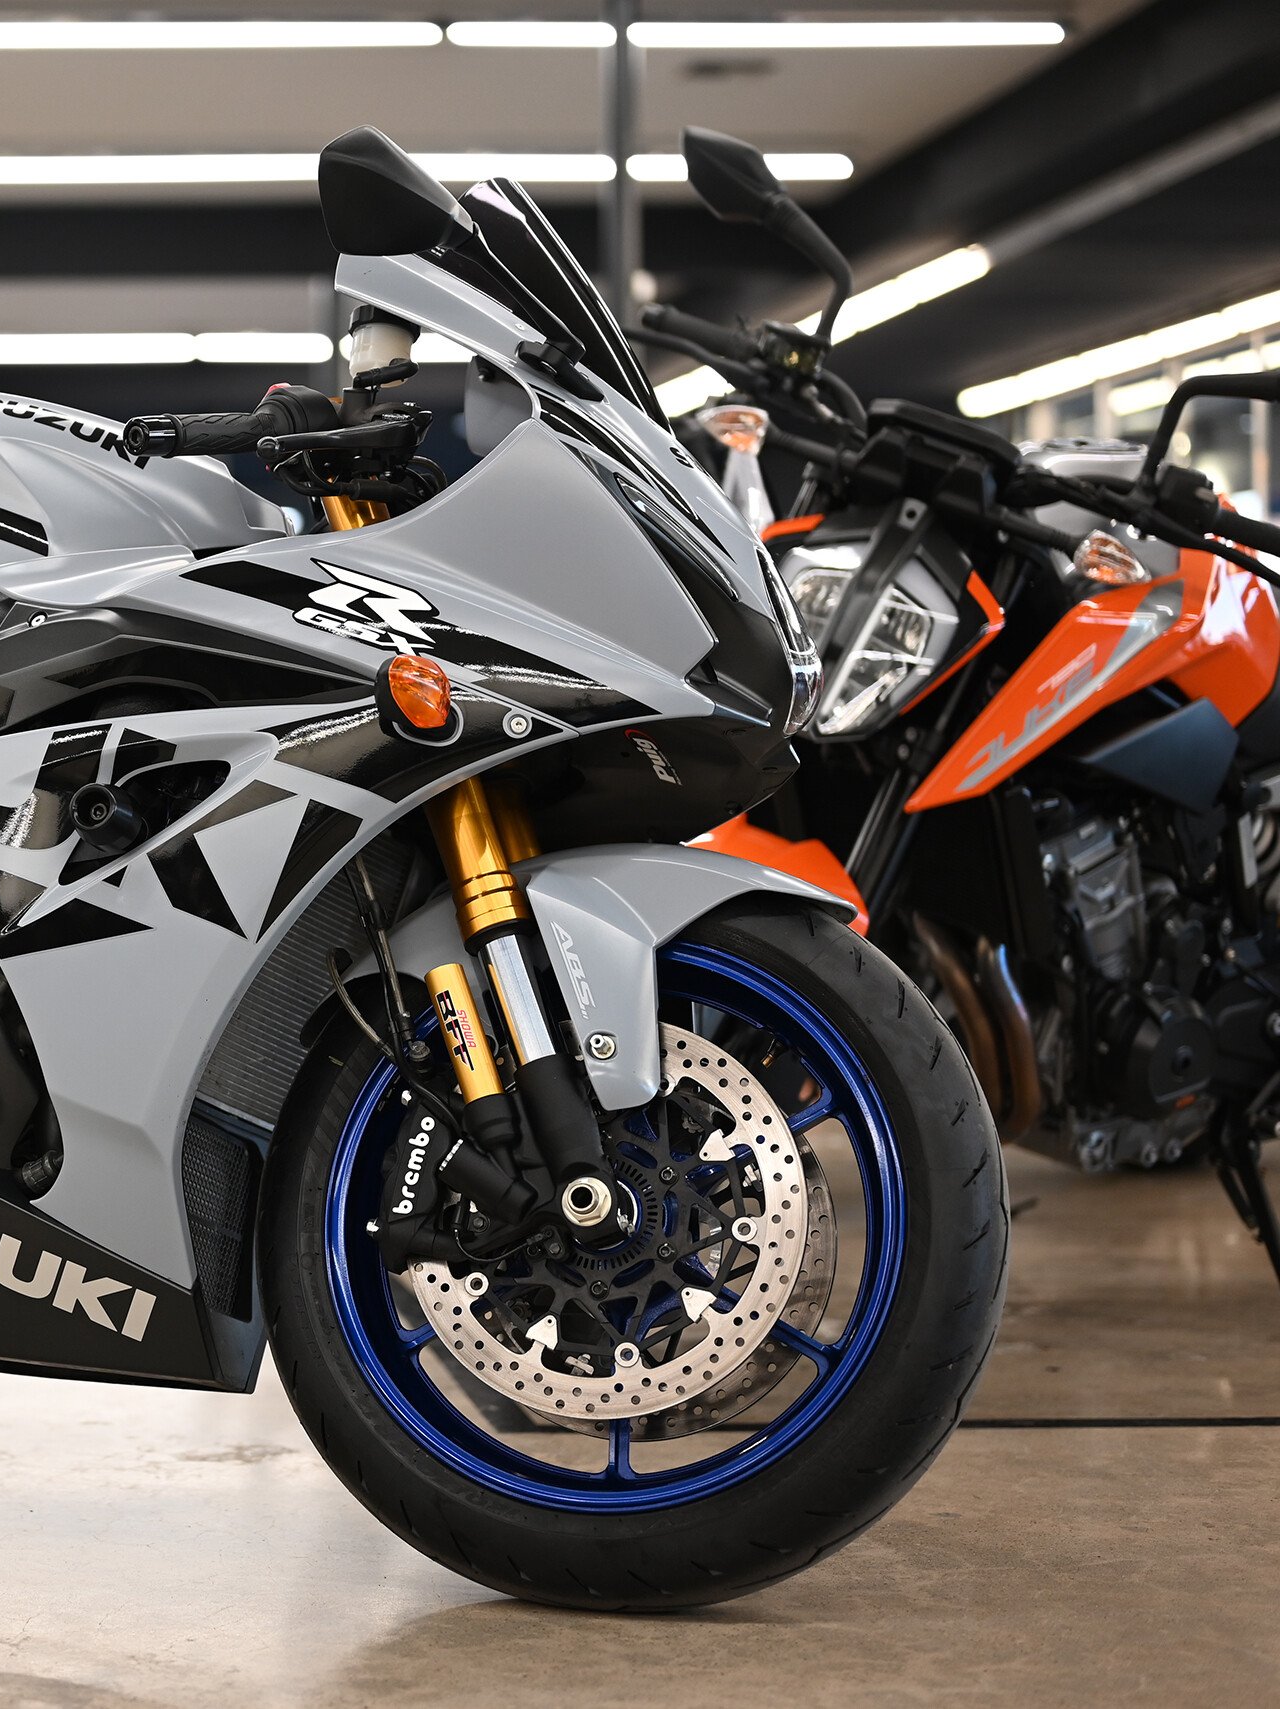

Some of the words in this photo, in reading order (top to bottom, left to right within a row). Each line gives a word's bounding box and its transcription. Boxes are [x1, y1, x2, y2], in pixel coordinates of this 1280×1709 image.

[632, 737, 677, 784] Puig
[549, 920, 597, 1010] ABS
[456, 1009, 477, 1049] SHOWA
[391, 1115, 436, 1215] brembo
